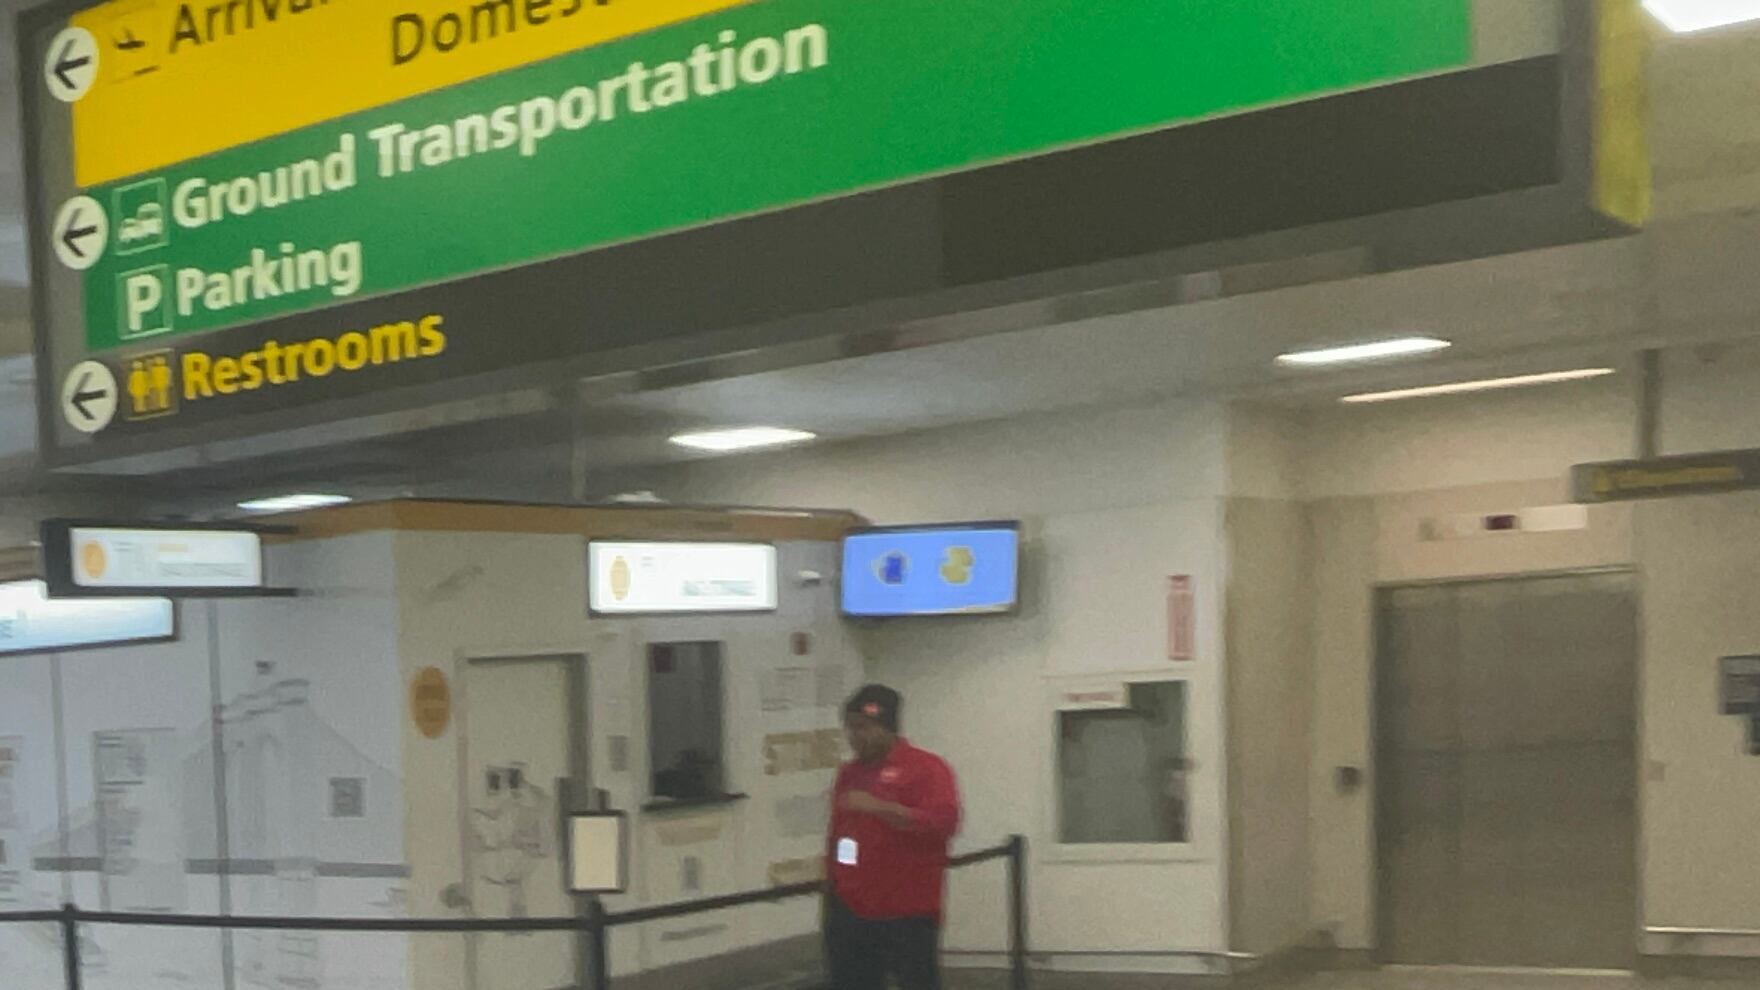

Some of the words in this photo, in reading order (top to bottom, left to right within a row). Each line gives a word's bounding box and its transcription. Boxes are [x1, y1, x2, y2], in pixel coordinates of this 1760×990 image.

[167, 0, 328, 54] Arriv
[391, 0, 611, 65] Dome
[172, 133, 357, 229] Ground
[367, 22, 828, 178] Transportation
[125, 273, 163, 331] P
[176, 241, 362, 316] Parking
[181, 314, 446, 400] Restrooms
